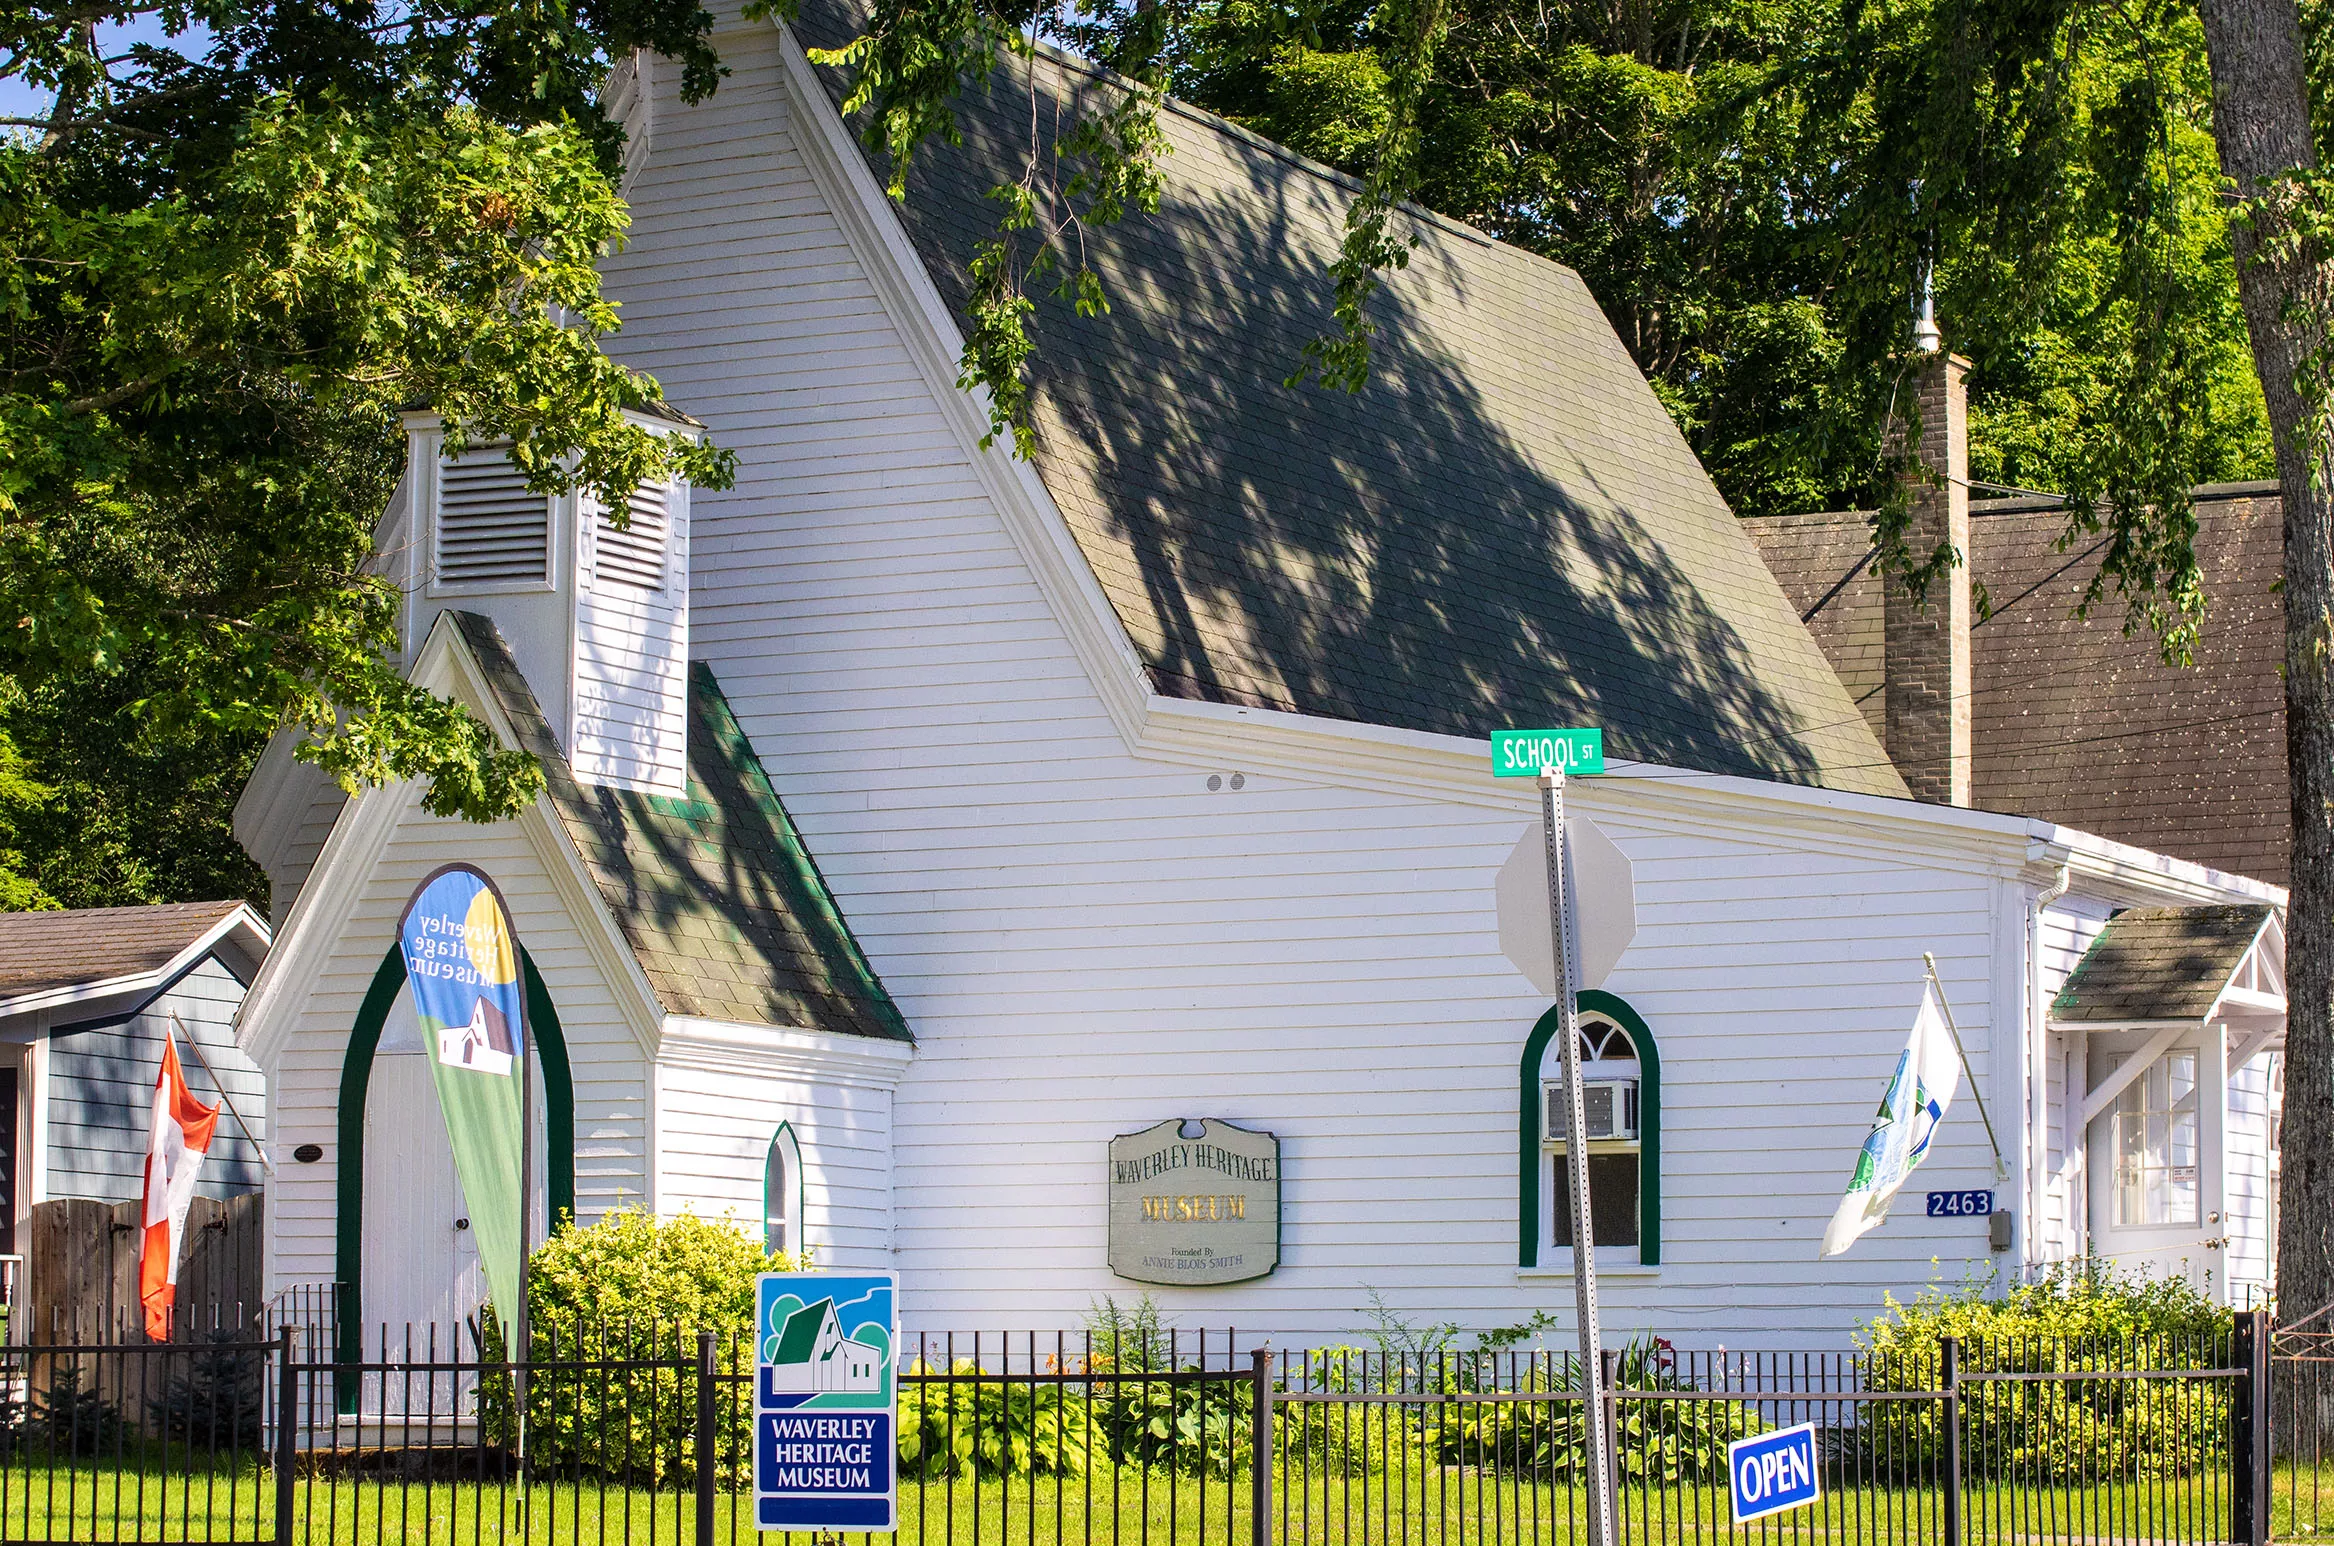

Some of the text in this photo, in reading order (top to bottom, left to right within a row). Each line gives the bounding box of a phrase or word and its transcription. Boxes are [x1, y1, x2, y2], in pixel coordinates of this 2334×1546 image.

[1503, 738, 1593, 768] SCHOOL ST
[1115, 1144, 1272, 1184] WAVERLEY HERITAGE
[1141, 1195, 1245, 1221] MUSEUM
[1932, 1192, 1989, 1215] 2463
[1142, 1254, 1243, 1270] ANNIE BLOIS SMITH
[1171, 1247, 1214, 1258] Founded By
[772, 1419, 876, 1439] WAVERLEY
[776, 1443, 872, 1464] HERITAGE
[778, 1467, 870, 1488] MUSEUM
[1740, 1442, 1810, 1503] OPEN
